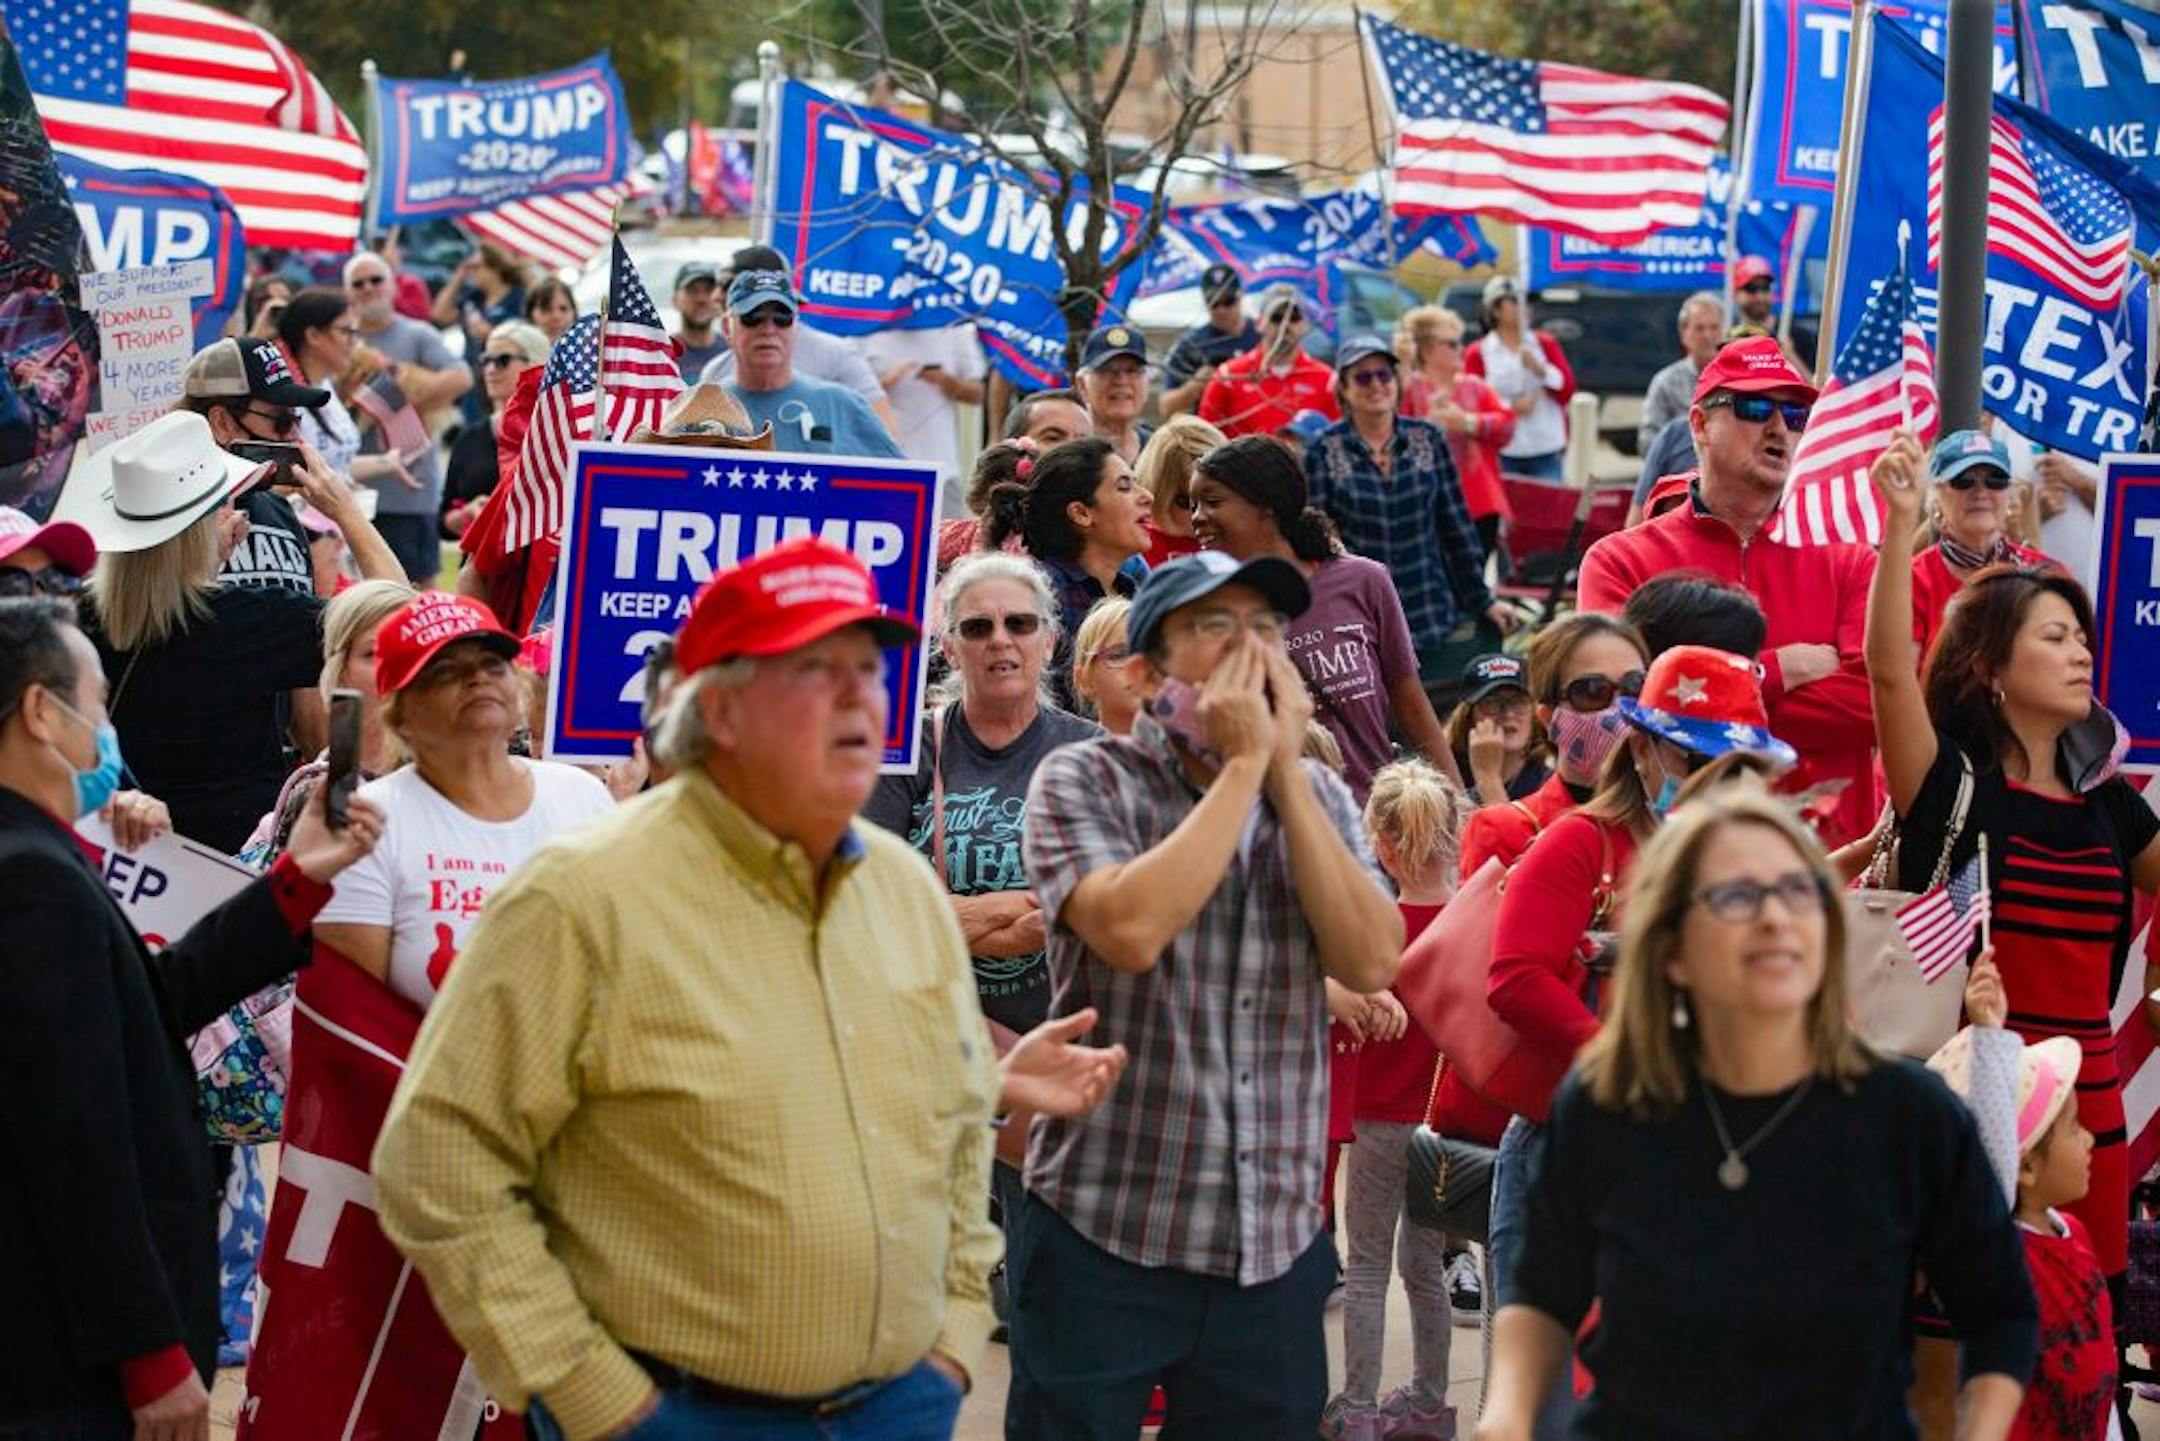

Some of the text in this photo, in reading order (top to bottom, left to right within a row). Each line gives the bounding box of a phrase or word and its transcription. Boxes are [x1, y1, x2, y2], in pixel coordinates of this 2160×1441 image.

[410, 84, 605, 140] TRUMP
[2076, 124, 2147, 159] AKE
[825, 124, 1119, 261] TRUMP
[809, 268, 884, 298] KEEP
[102, 306, 173, 328] DONALD
[111, 324, 184, 350] TRUMP
[105, 358, 182, 388] 4 MORE
[129, 382, 184, 403] YEARS
[89, 415, 119, 434] WE
[600, 591, 671, 618] KEEP
[426, 853, 507, 874] I am an
